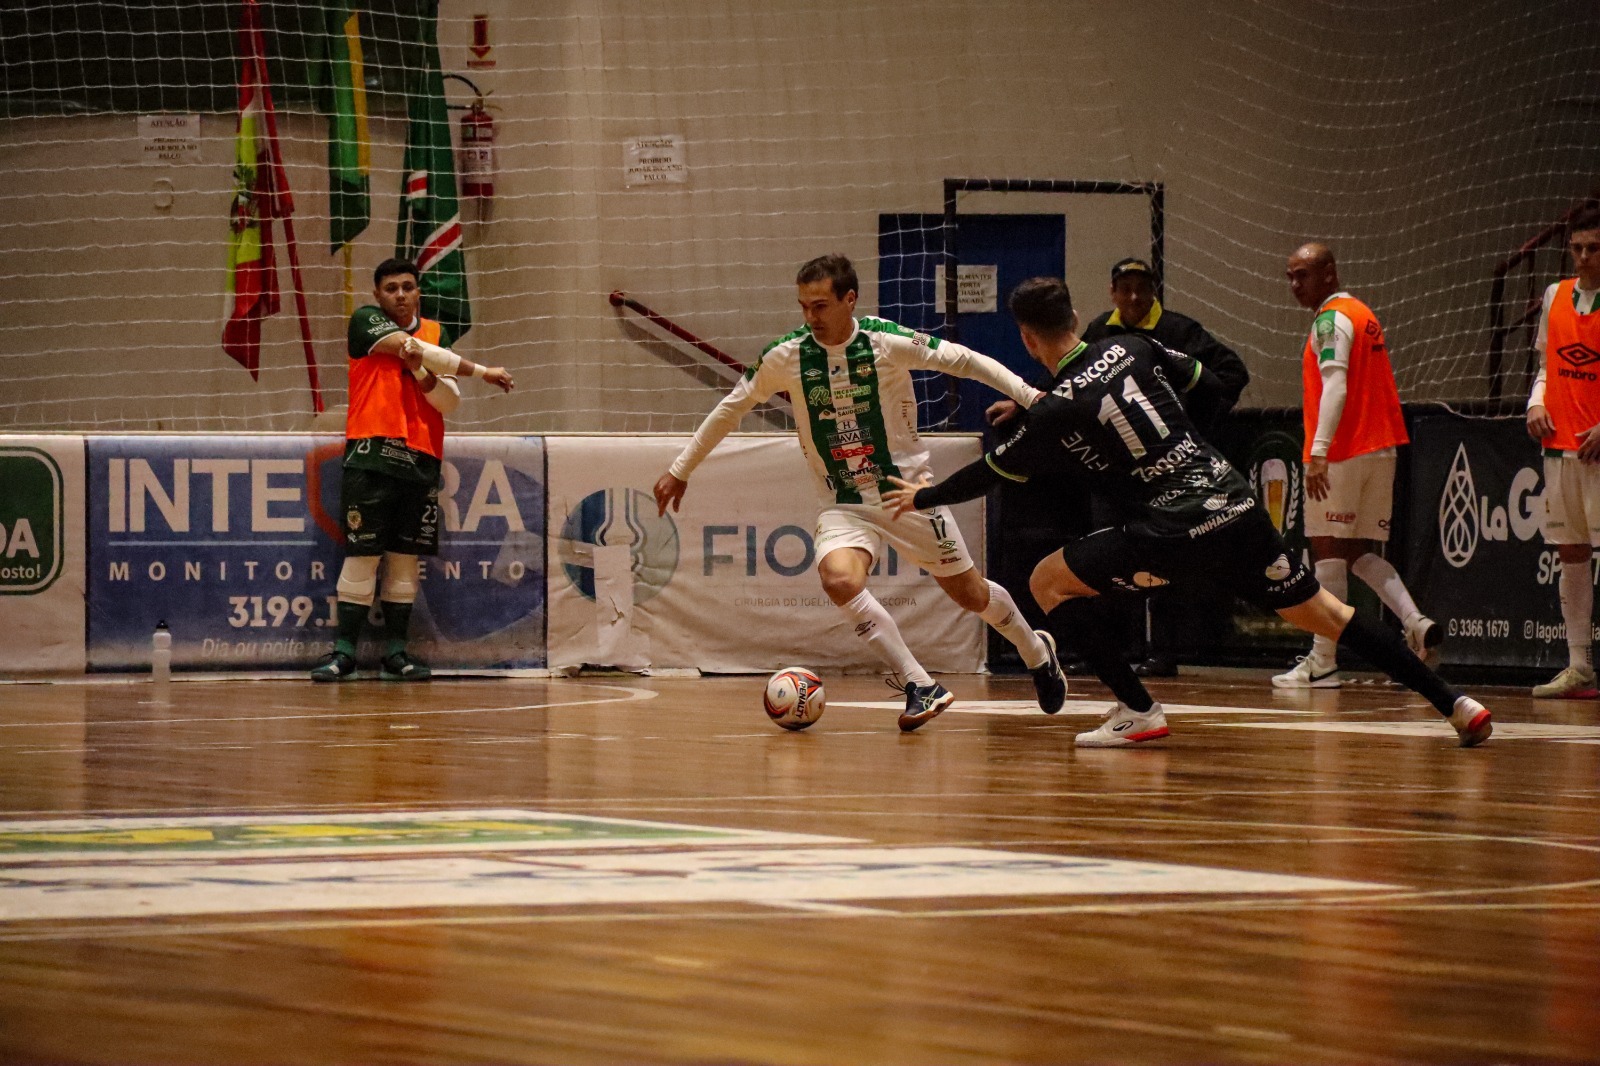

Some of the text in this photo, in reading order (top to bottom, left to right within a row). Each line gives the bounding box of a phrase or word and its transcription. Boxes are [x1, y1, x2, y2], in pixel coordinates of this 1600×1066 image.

[1073, 344, 1127, 389] SICOOB
[1100, 355, 1135, 384] Creditaipu
[1558, 367, 1598, 381] umbro
[1097, 375, 1169, 460] 11
[929, 514, 946, 540] 17
[1188, 497, 1256, 539] PINHALZINHO
[109, 560, 526, 582] MONITORENTO
[1459, 618, 1509, 638] 3366 1679
